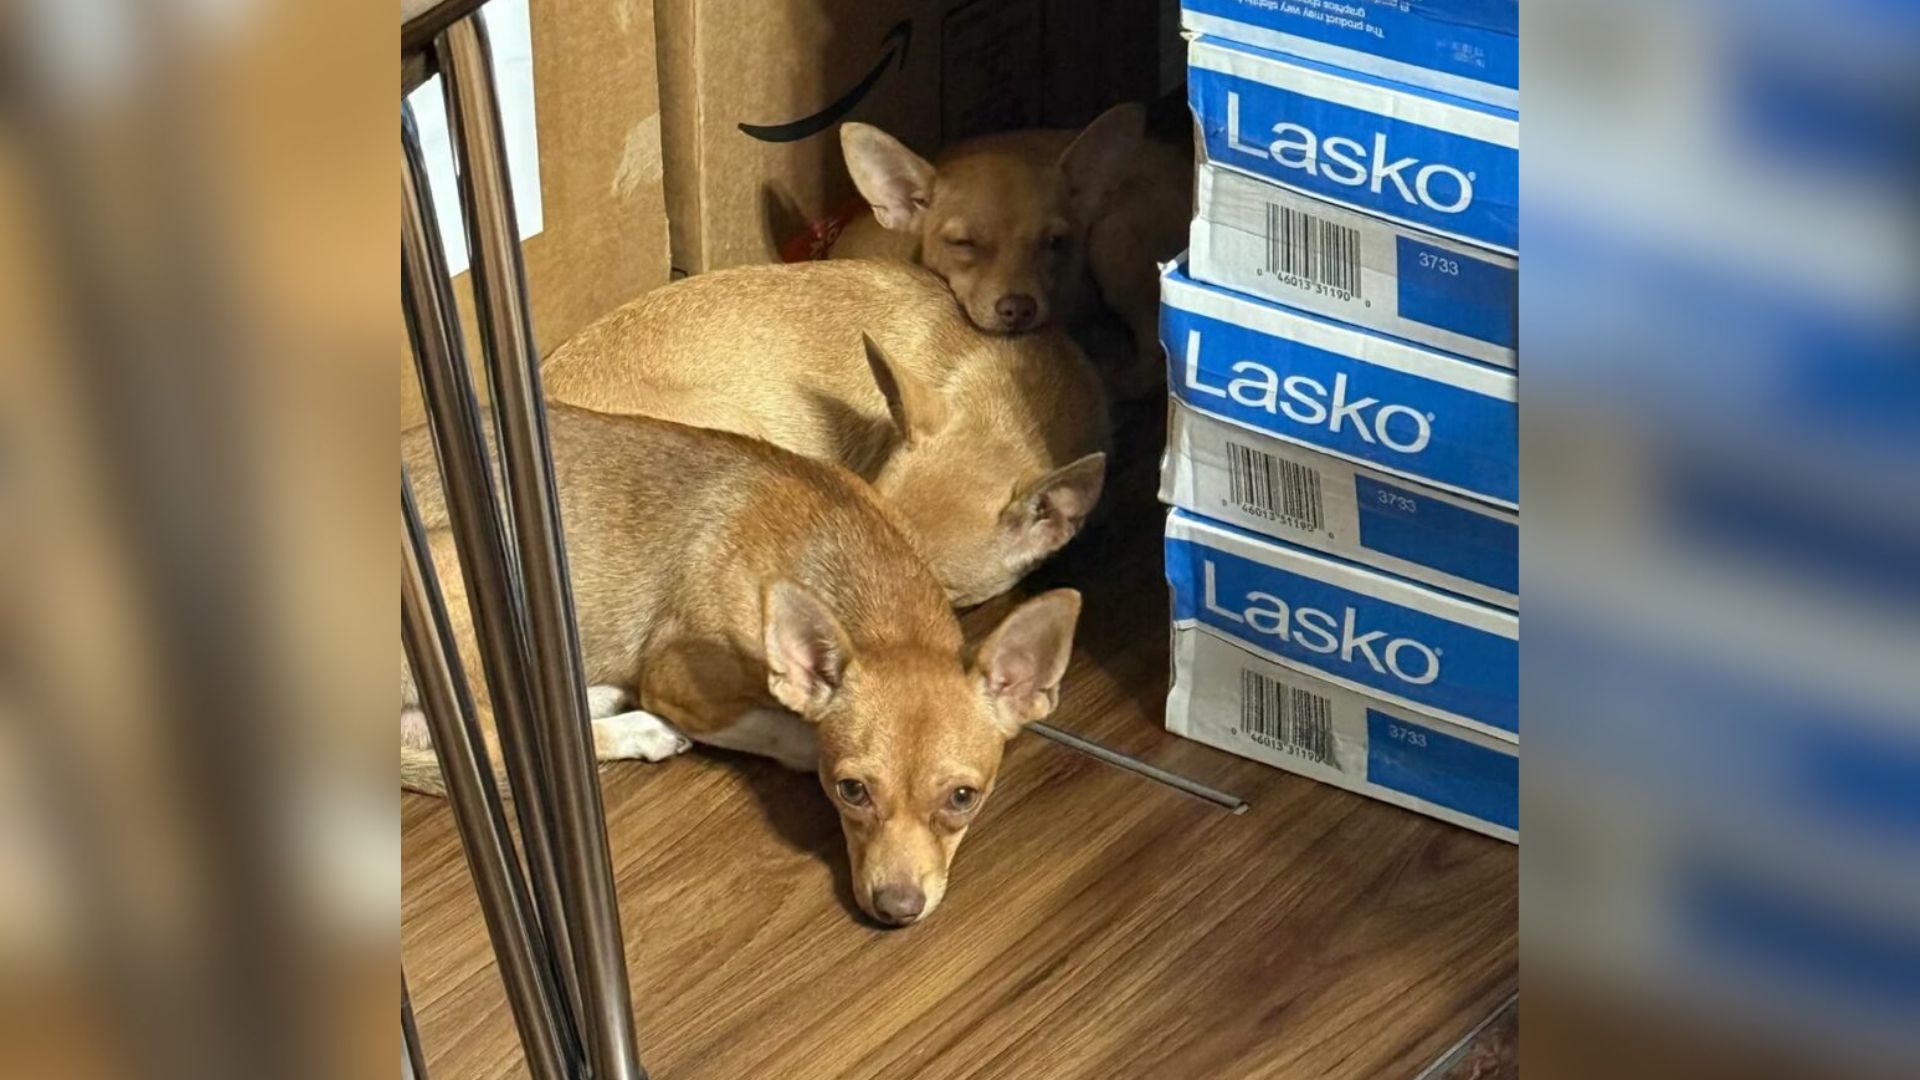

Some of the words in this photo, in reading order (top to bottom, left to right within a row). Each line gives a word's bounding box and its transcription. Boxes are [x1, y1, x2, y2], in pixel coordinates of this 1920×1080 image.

[1280, 1, 1302, 16] vary
[1303, 7, 1324, 22] may
[1322, 0, 1366, 18] graphics
[1325, 14, 1364, 31] product
[1366, 24, 1385, 39] The
[1226, 91, 1474, 215] Lasko
[1418, 251, 1460, 276] 3733
[1256, 268, 1263, 276] 0
[1277, 273, 1312, 292] 46013
[1315, 284, 1351, 303] 31190
[1184, 330, 1432, 454] Lasko
[1377, 490, 1417, 513] 3733
[1203, 560, 1440, 686] Lasko
[1388, 725, 1427, 749] 3733
